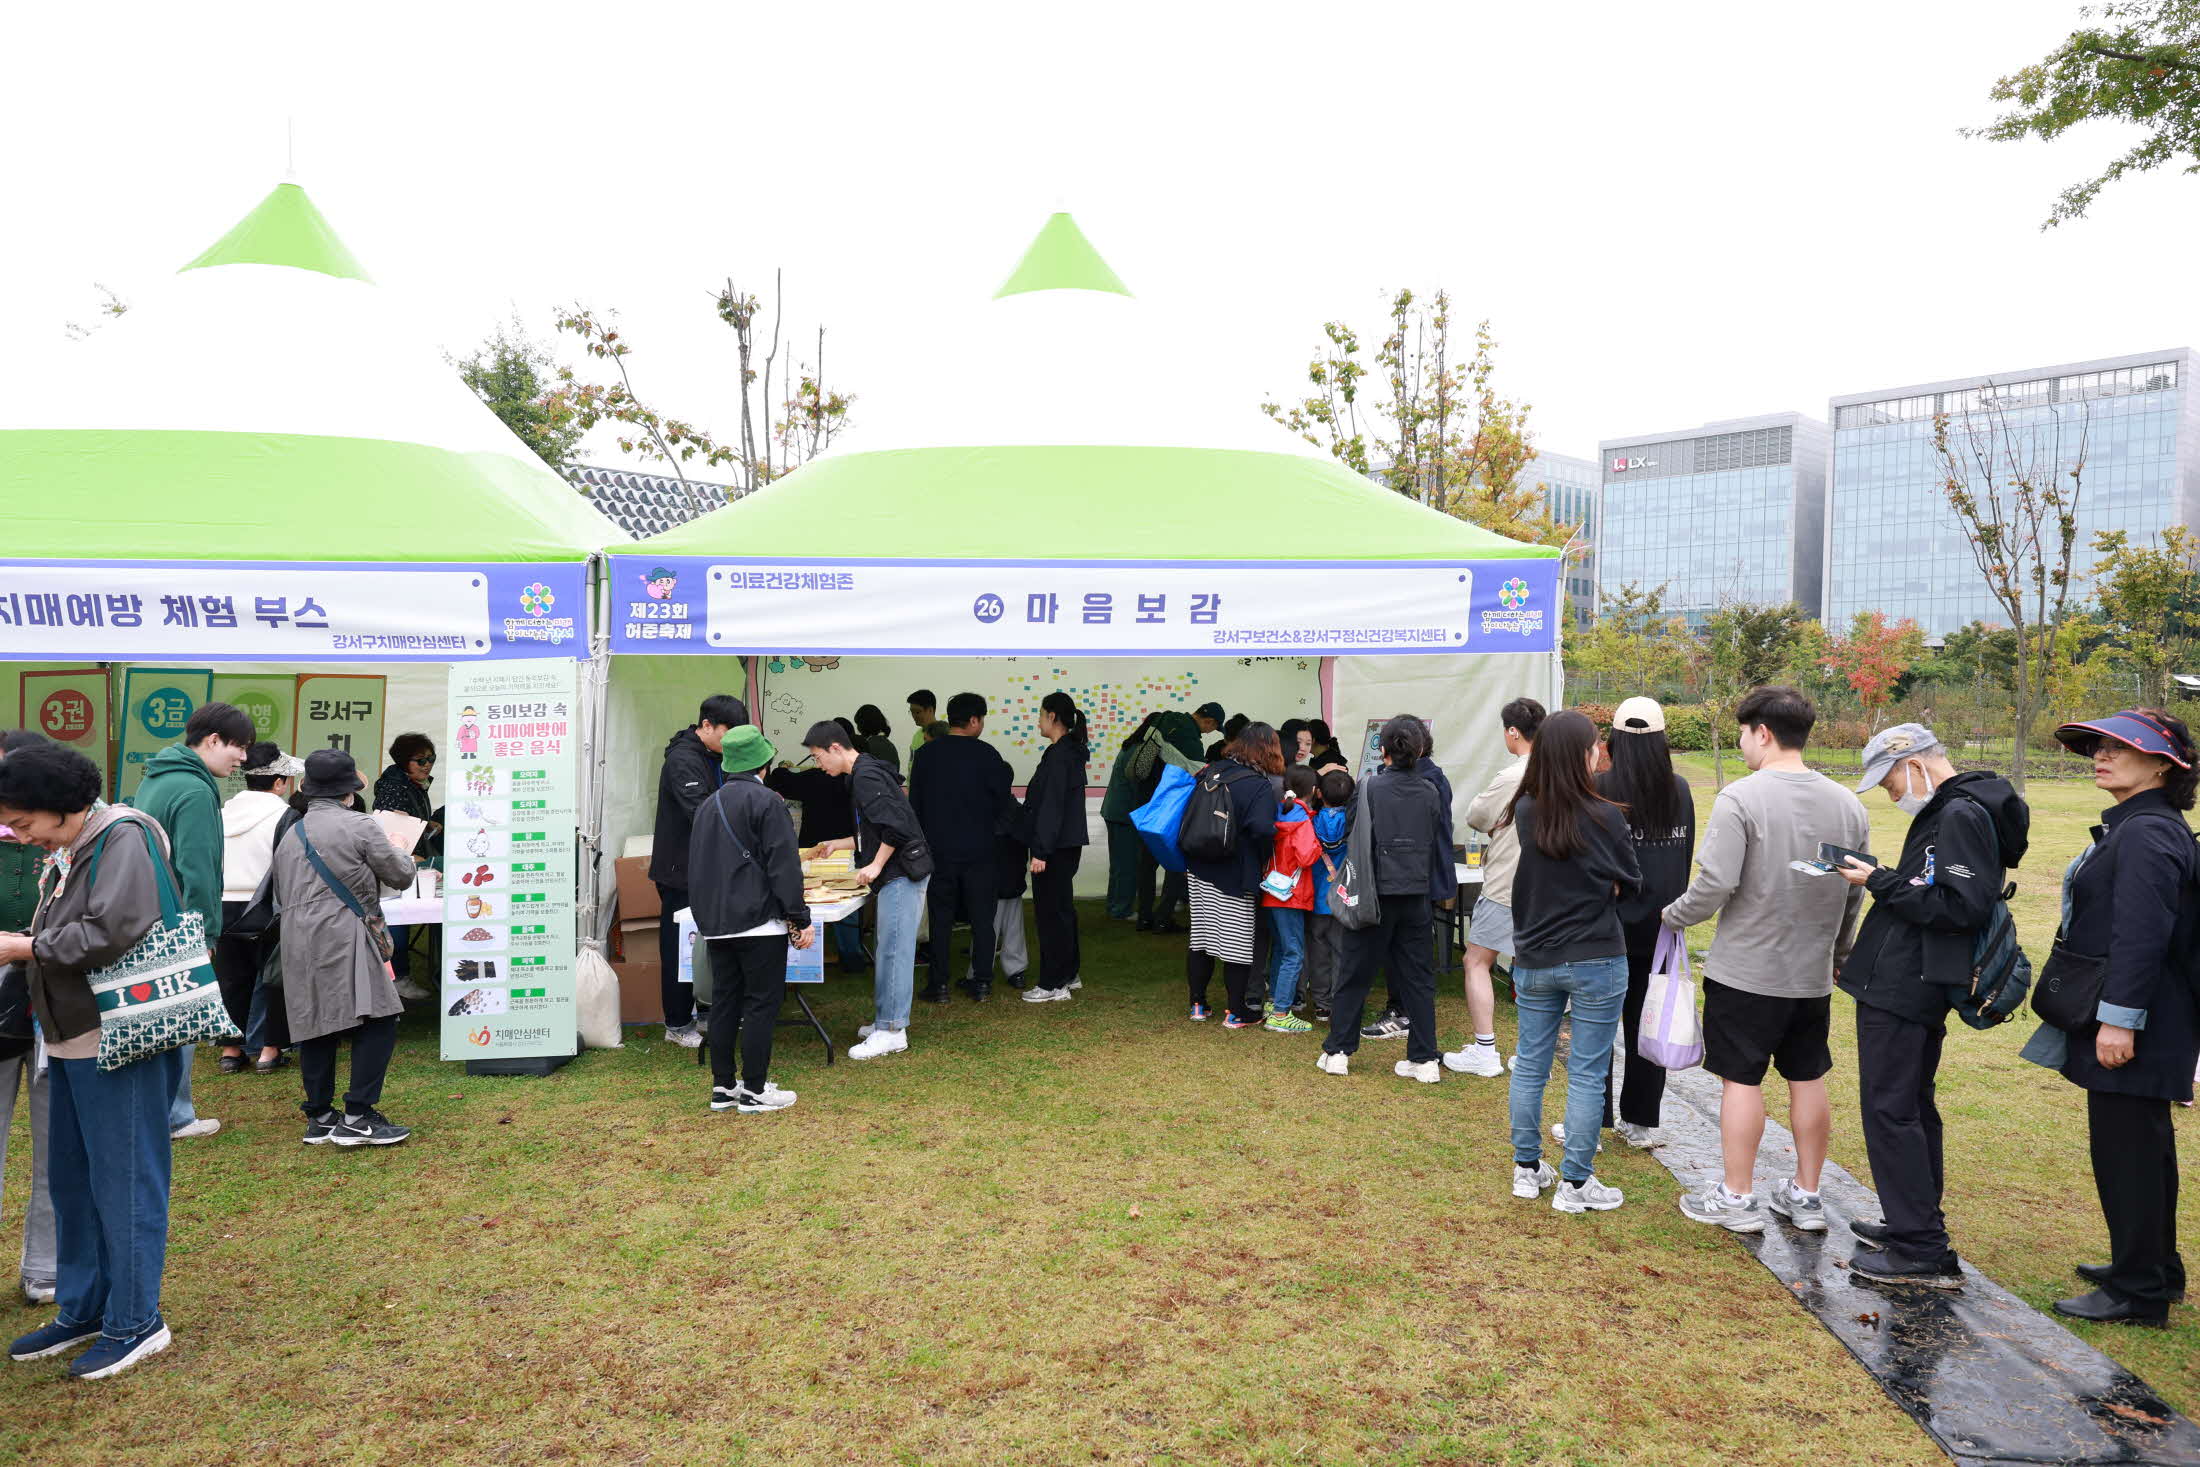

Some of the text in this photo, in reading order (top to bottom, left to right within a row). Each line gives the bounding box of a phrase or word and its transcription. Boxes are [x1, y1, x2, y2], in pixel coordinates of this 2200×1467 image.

[1628, 456, 1647, 469] LX
[730, 571, 854, 591] 의료건강체험존
[160, 594, 238, 628] 체험
[254, 596, 330, 629] 부스
[630, 602, 688, 620] 제23회
[977, 601, 1001, 617] 26
[626, 623, 692, 639] 허준축제
[1213, 629, 1446, 644] 강서구보건소&강서구정신건강복지센터
[332, 634, 466, 650] 강서구치매안심센터
[47, 700, 84, 730] 3권
[148, 698, 186, 727] 3금
[310, 701, 372, 720] 강서구
[488, 702, 567, 719] 동의보감 속
[488, 722, 567, 739] 치매예방에
[494, 740, 560, 757] 좋은 음식
[154, 970, 199, 999] HK
[495, 1028, 550, 1040] 치매안심센터
